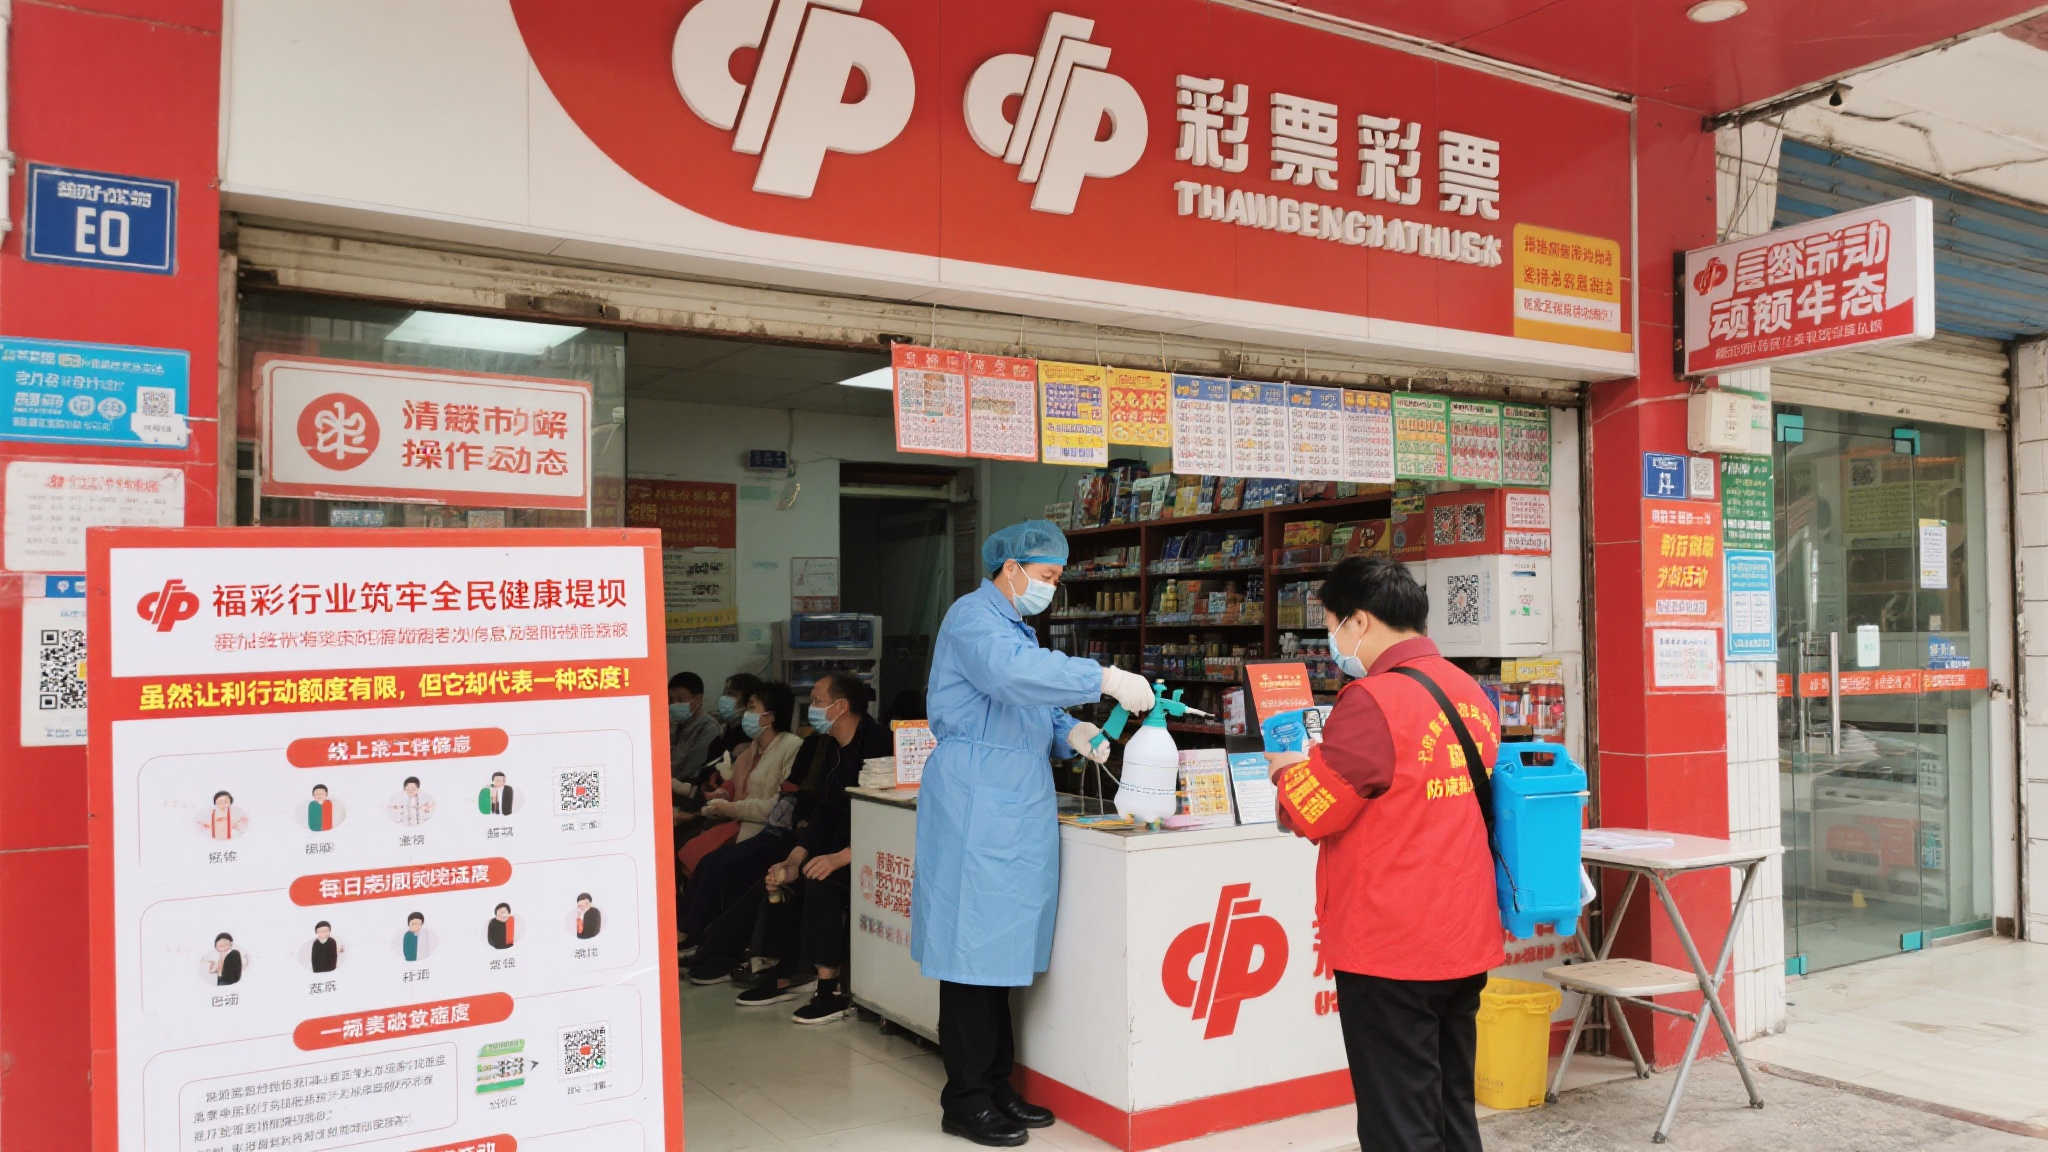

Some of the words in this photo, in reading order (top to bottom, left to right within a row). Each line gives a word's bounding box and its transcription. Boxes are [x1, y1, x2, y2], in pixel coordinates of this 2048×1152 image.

[1175, 73, 1501, 221] 彩票彩票
[212, 578, 628, 617] 福彩行业筑牢全民健康堤坝
